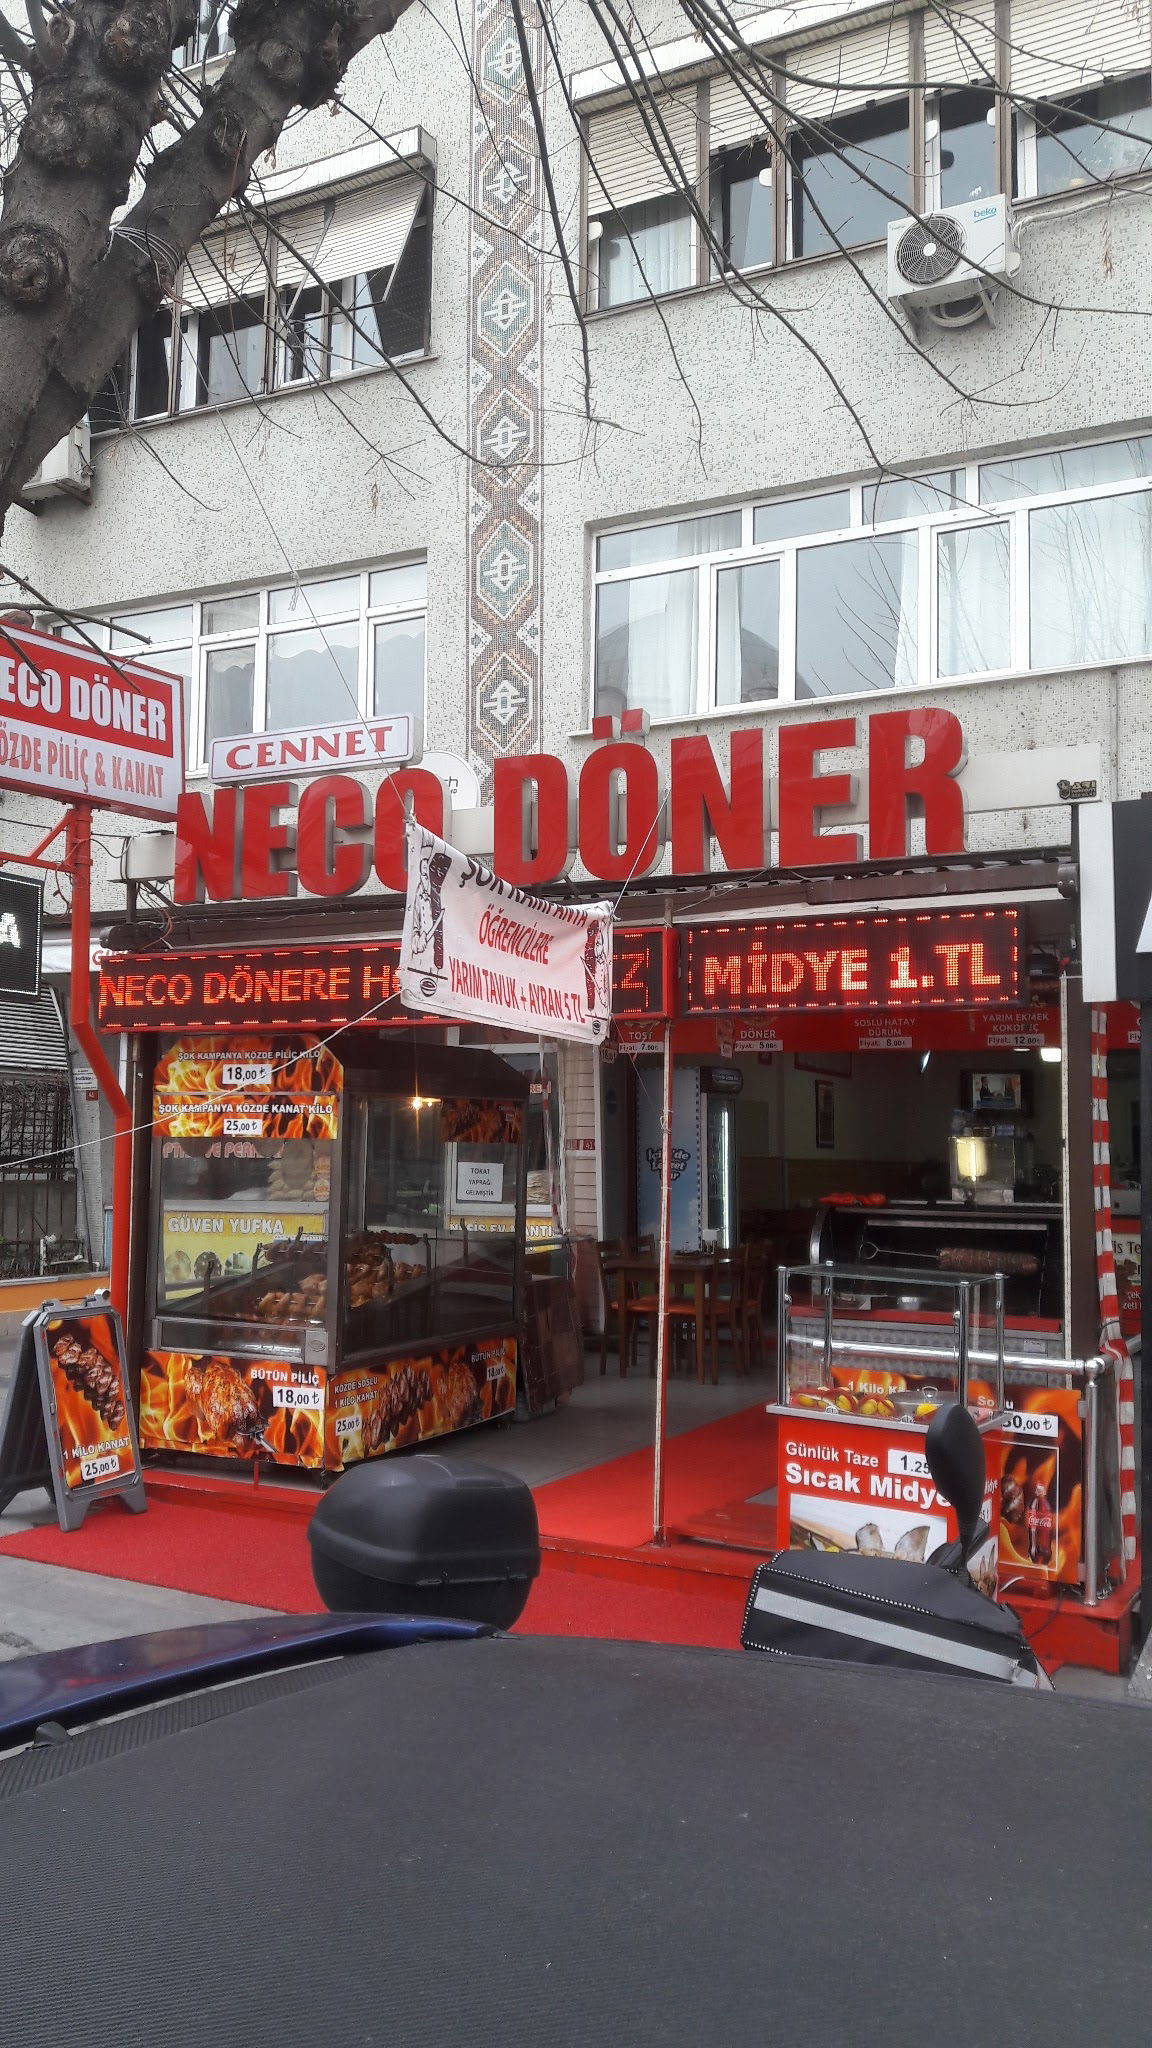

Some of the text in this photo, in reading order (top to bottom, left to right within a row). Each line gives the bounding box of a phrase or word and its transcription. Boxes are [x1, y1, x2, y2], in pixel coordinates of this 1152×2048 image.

[973, 207, 997, 218] beko
[70, 674, 166, 741] DÖNER
[226, 726, 393, 770] CENNET
[48, 736, 89, 793] PİLİÇ
[95, 752, 106, 786] &
[112, 756, 163, 798] KANAT
[174, 708, 966, 904] NECO DÖNER
[479, 904, 554, 965] ÖĞRENCİLERE
[704, 942, 1001, 996] MİDYE 1.TL
[99, 973, 193, 1007] NECO
[203, 964, 350, 1004] DÖNERE
[449, 956, 483, 1001] YARIM
[482, 968, 519, 1010] TAVUK
[528, 983, 564, 1019] AYRAN
[571, 993, 586, 1024] TL
[854, 1017, 915, 1027] SOSLU HATAY
[983, 1013, 1049, 1022] YARIM EKMEK
[629, 1031, 654, 1040] TOST
[740, 1028, 776, 1039] DÖNER
[178, 1051, 195, 1062] ŞOK
[197, 1051, 242, 1060] KAMPANYA
[159, 1102, 333, 1114] ŞOK KAMPANYA KÖZDE KANAT KİLO
[167, 1213, 284, 1234] GÜVEN YUFKA
[251, 1368, 320, 1387] BÜTÜN PİLİÇ
[848, 1380, 854, 1391] 1
[860, 1382, 885, 1394] Kilo
[63, 1435, 130, 1460] 1 KİLO KANAT
[786, 1441, 879, 1468] Günlük Taze
[785, 1462, 861, 1494] Sıcak
